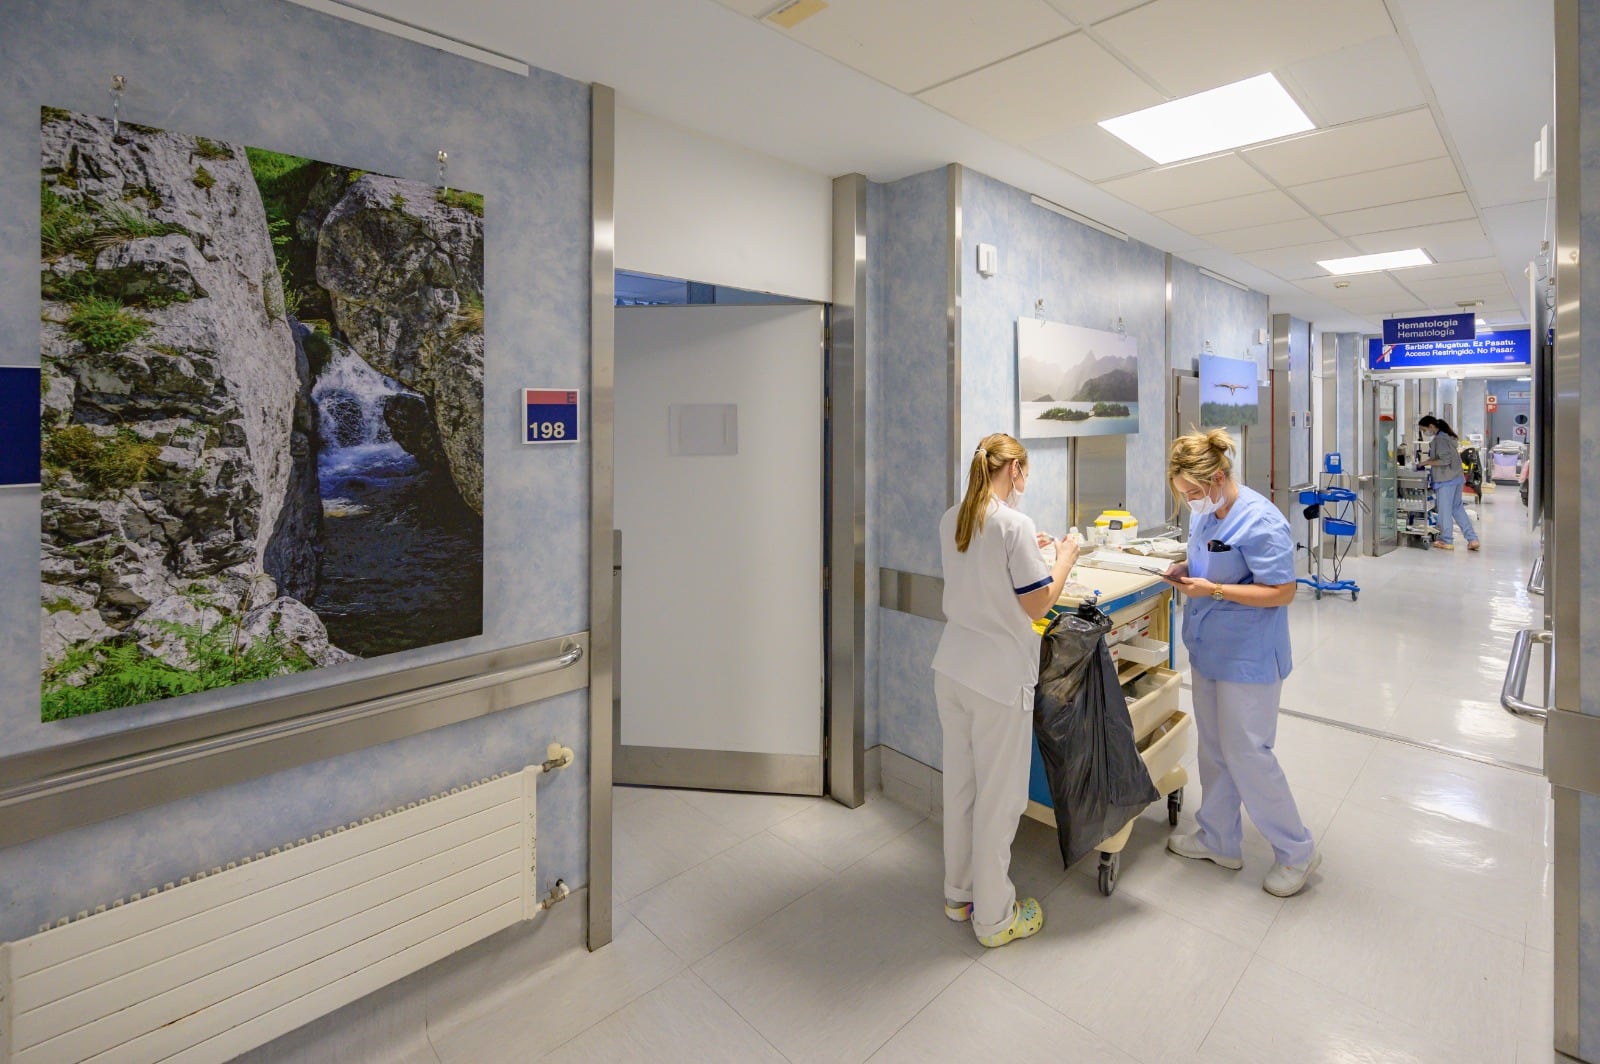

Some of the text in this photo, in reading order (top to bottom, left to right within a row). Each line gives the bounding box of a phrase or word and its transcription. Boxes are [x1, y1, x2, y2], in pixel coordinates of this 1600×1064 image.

[1435, 342, 1471, 350] Mugatua.
[1485, 339, 1516, 347] Pasatu.
[1432, 348, 1475, 357] Restringido.
[529, 421, 565, 439] 198
